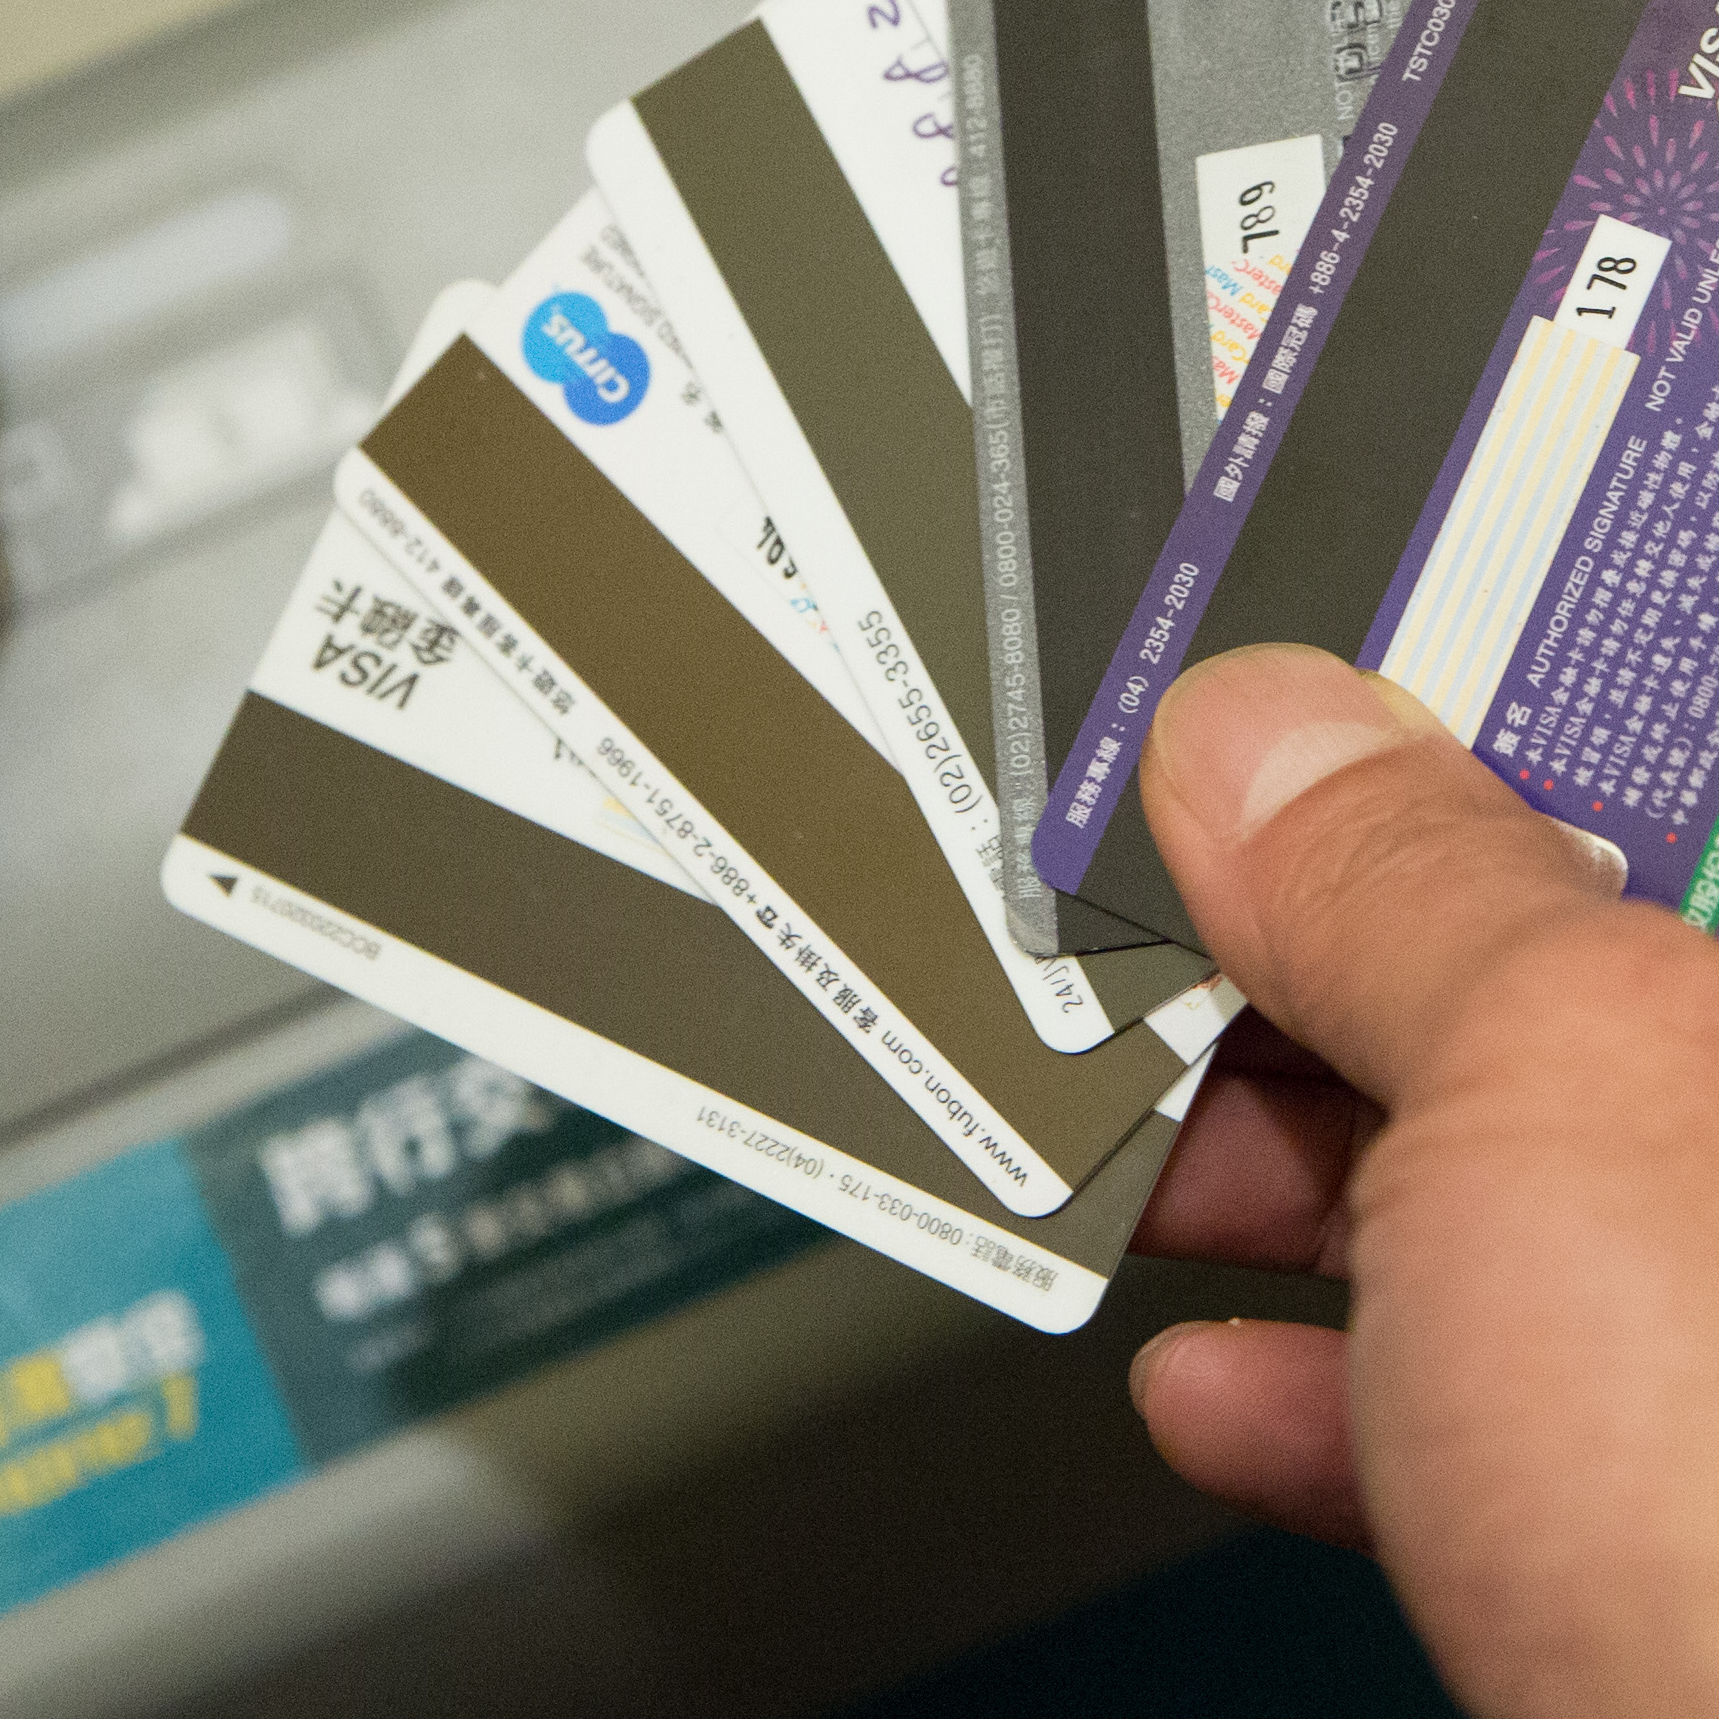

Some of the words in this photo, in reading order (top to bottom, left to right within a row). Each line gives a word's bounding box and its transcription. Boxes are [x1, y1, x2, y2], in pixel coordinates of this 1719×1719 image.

[1238, 180, 1280, 254] 789
[1303, 119, 1401, 297] +886-4-2354-2030
[538, 303, 635, 411] Cirrus
[1644, 365, 1679, 413] NOT
[1664, 304, 1705, 367] VALID
[1136, 558, 1202, 665] 2354-2030
[1521, 552, 1598, 688] AUTHORIZED
[1580, 433, 1649, 554] SIGNATURE
[307, 630, 421, 713] VISA
[310, 571, 462, 676] 金融卡
[592, 733, 763, 910] +886-2-8751-1966
[693, 1102, 827, 1180] (04)2227-3131
[874, 1027, 1032, 1191] www.fubon.com
